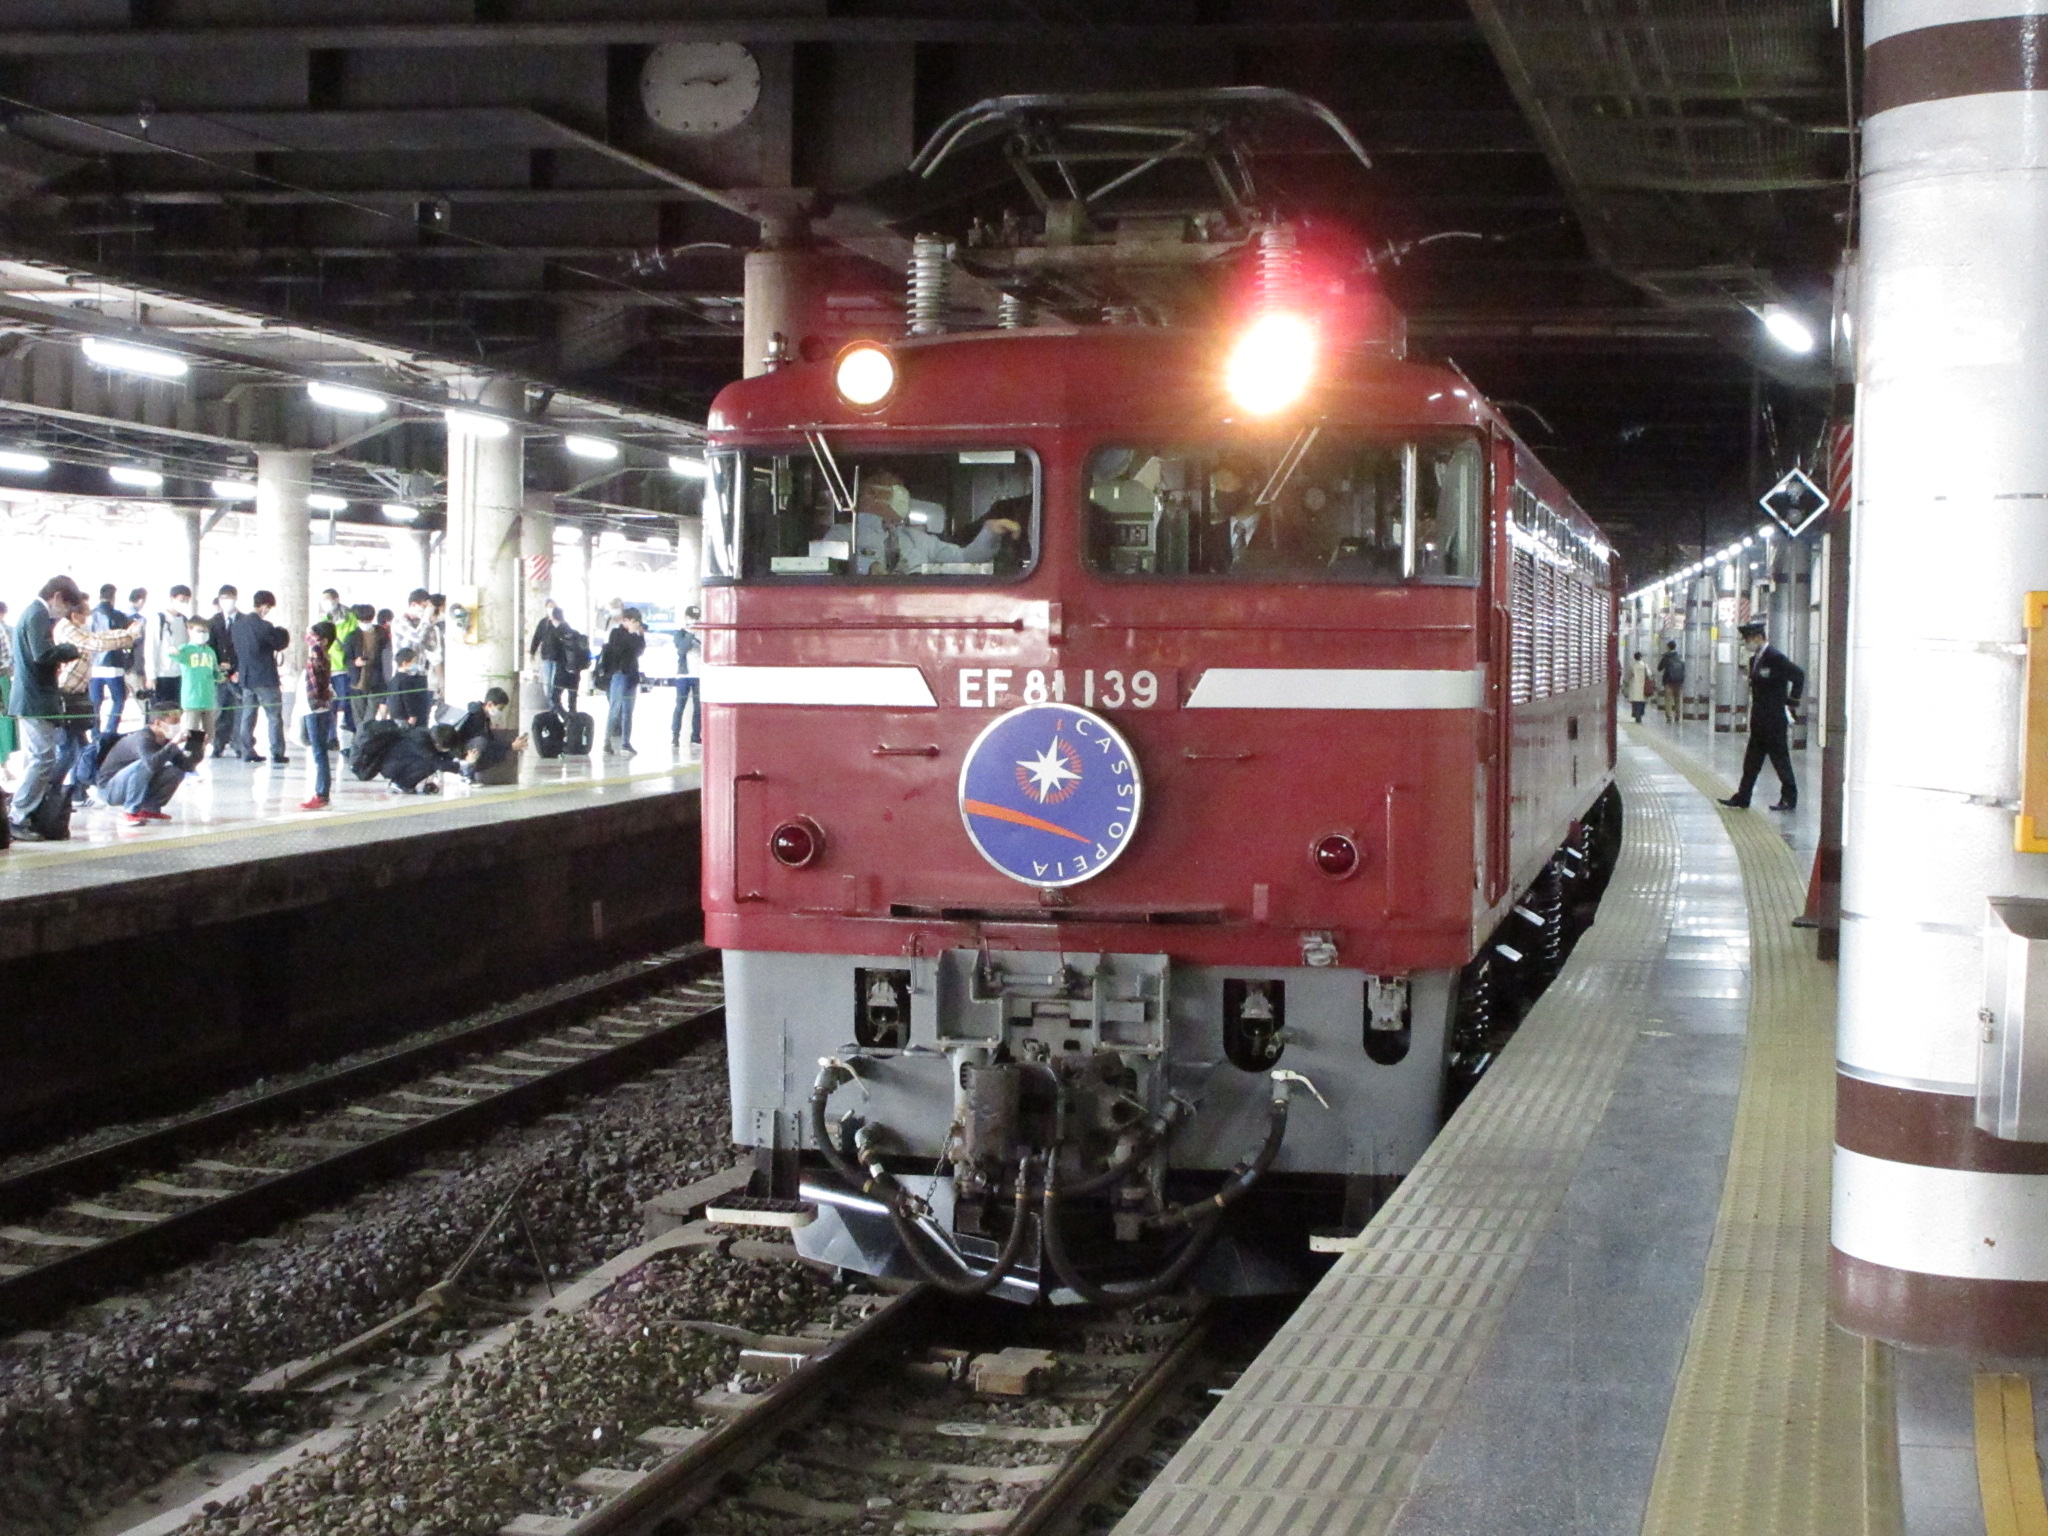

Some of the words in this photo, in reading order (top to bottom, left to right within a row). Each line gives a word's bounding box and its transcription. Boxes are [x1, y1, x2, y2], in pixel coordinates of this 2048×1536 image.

[959, 668, 1013, 708] EF
[1023, 669, 1066, 704] 81
[1084, 669, 1158, 708] 139
[1032, 718, 1133, 877] CASSIOPEIA
